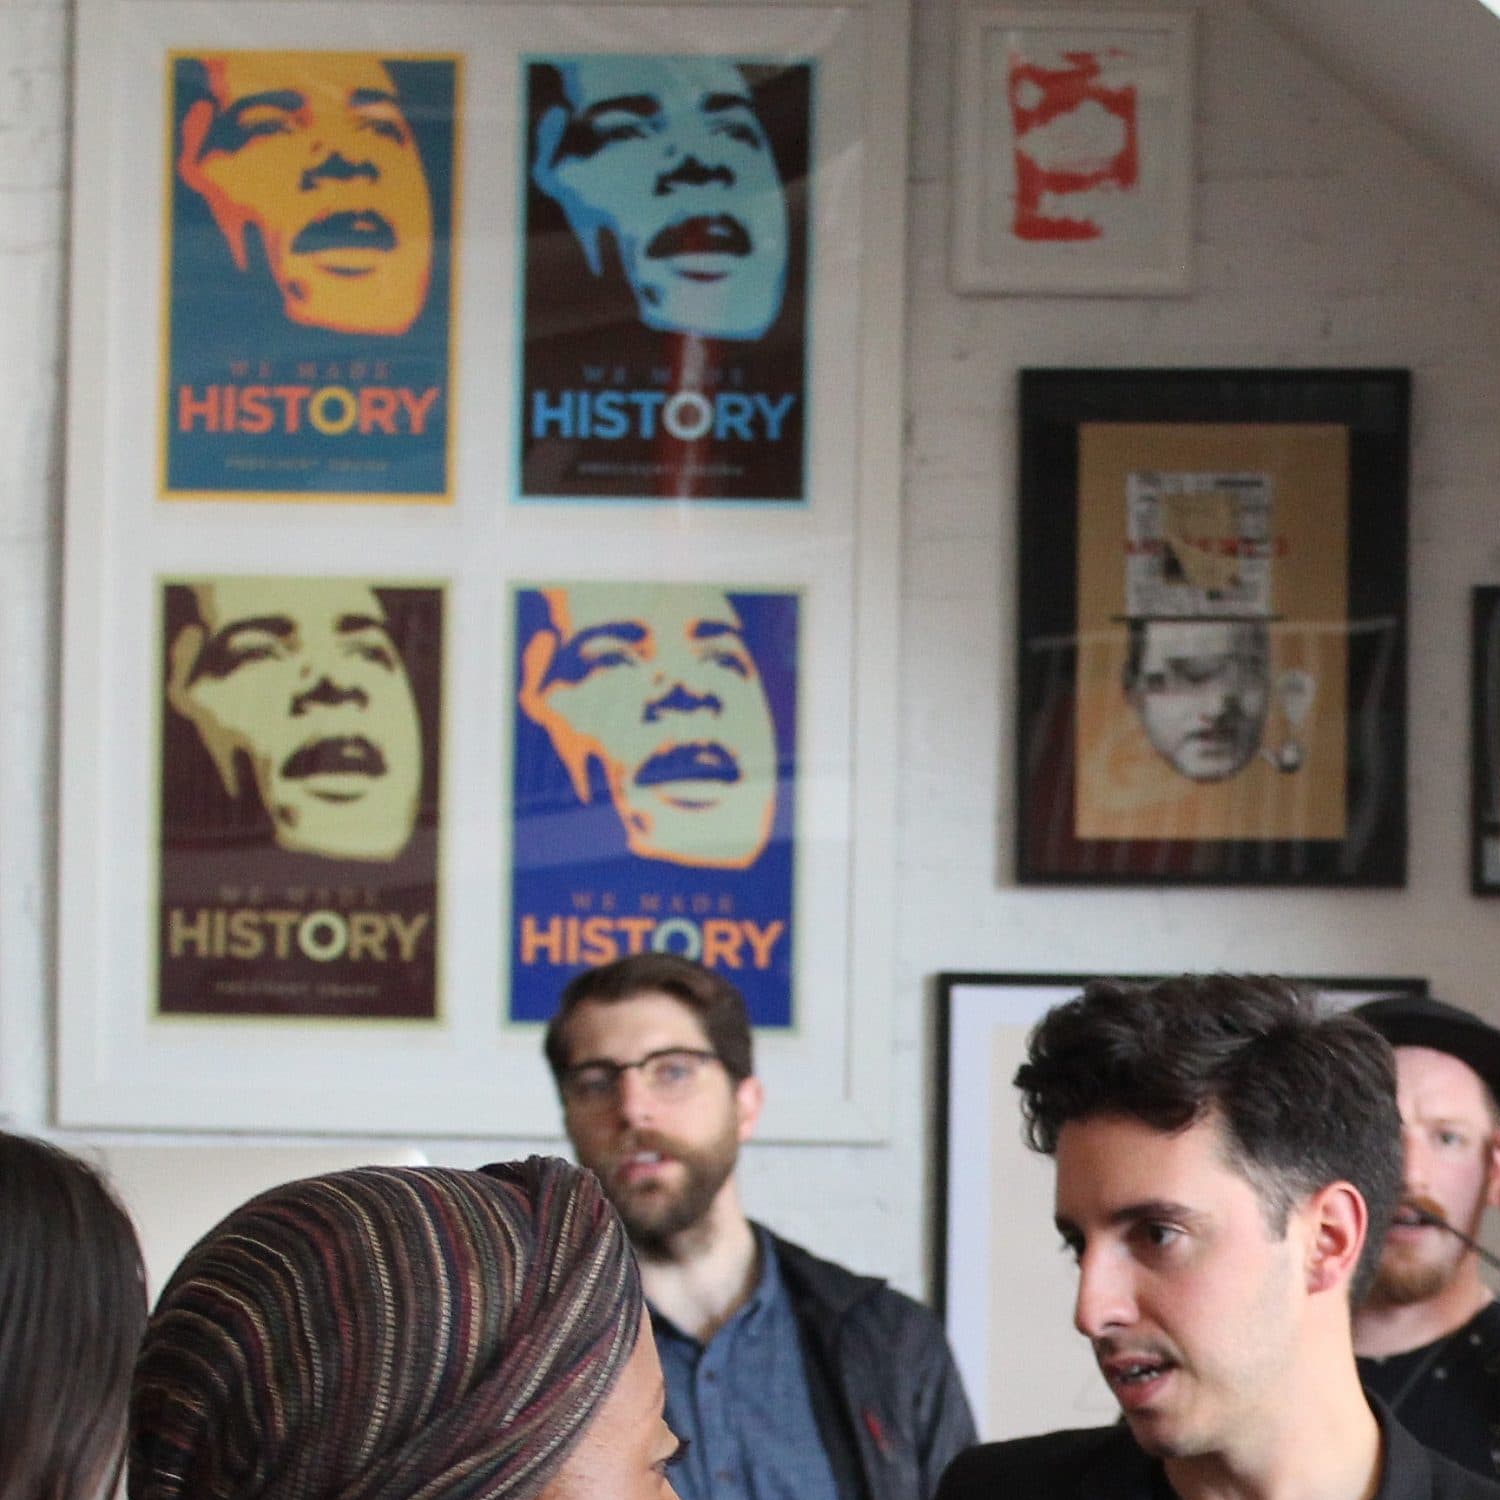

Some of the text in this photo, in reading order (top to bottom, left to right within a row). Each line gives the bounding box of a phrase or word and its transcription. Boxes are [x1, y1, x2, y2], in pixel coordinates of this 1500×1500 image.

[178, 385, 439, 436] HISTORY
[532, 390, 795, 442] HISTORY
[169, 908, 429, 962] HISTORY
[520, 915, 784, 970] HISTORY
